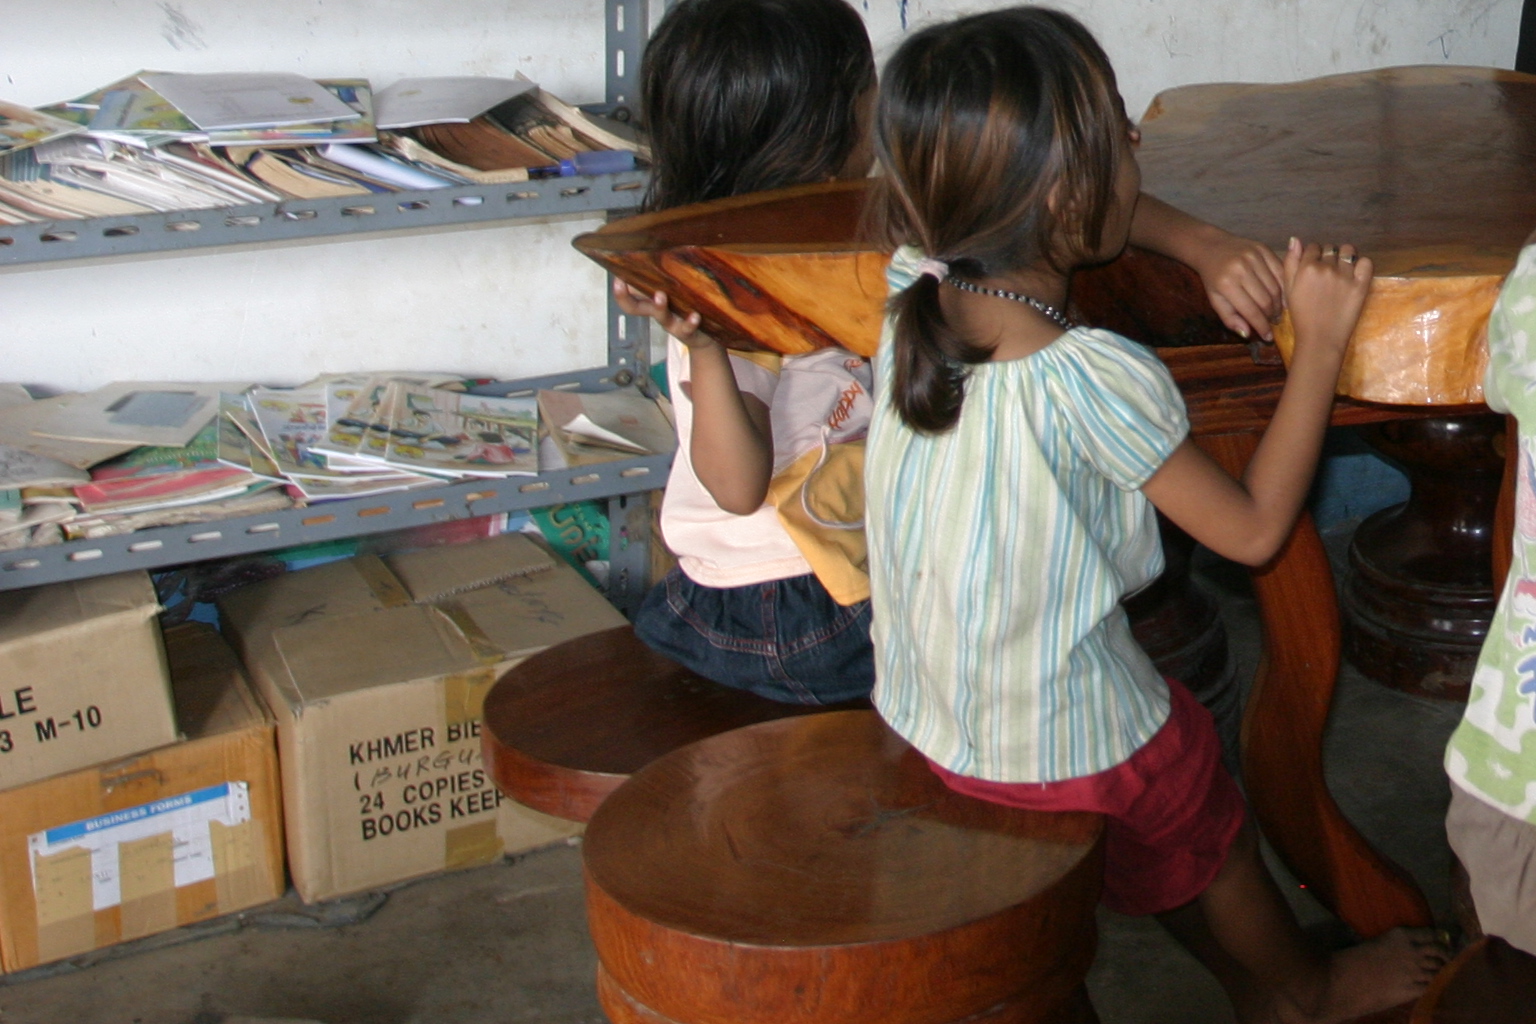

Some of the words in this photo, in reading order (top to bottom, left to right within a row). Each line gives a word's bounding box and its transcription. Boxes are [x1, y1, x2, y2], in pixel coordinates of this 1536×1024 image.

[34, 705, 102, 743] M-10
[350, 727, 435, 765] KHMER
[360, 792, 385, 815] 24
[403, 769, 485, 804] COPIES
[85, 806, 148, 832] BUSINESS
[150, 795, 193, 814] FORMS
[361, 803, 442, 841] BOOKS
